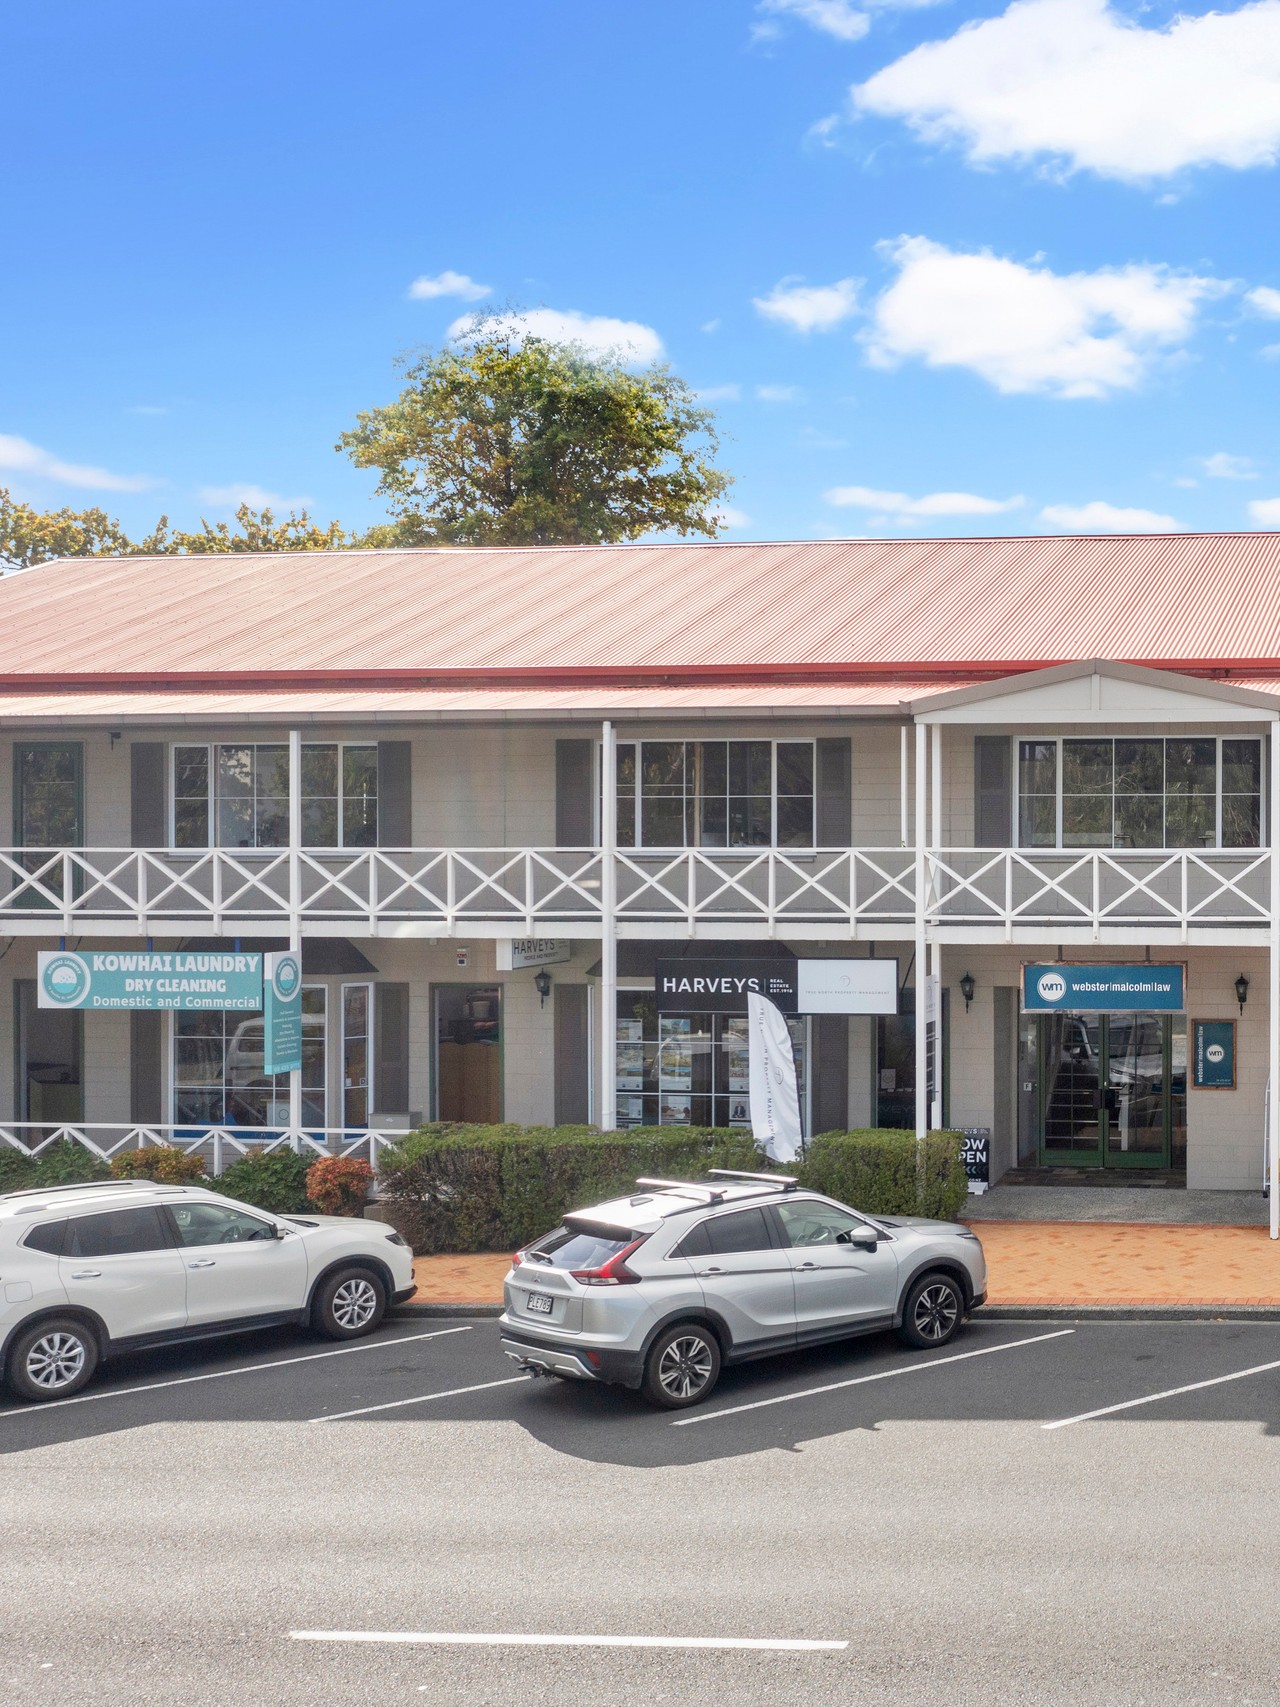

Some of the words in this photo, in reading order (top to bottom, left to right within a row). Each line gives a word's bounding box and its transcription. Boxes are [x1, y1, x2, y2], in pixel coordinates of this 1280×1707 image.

[513, 939, 555, 955] HARVEYS
[93, 955, 172, 972] KOWHAI
[175, 955, 259, 973] LAUNDRY
[125, 978, 154, 992] DRY
[156, 979, 226, 993] CLEANING
[663, 977, 760, 993] HARVEYS
[1041, 982, 1063, 991] wm
[93, 995, 153, 1007] Domestic
[157, 996, 181, 1007] and
[185, 996, 260, 1008] Commercial
[961, 1138, 986, 1150] OW
[958, 1151, 987, 1163] PEN
